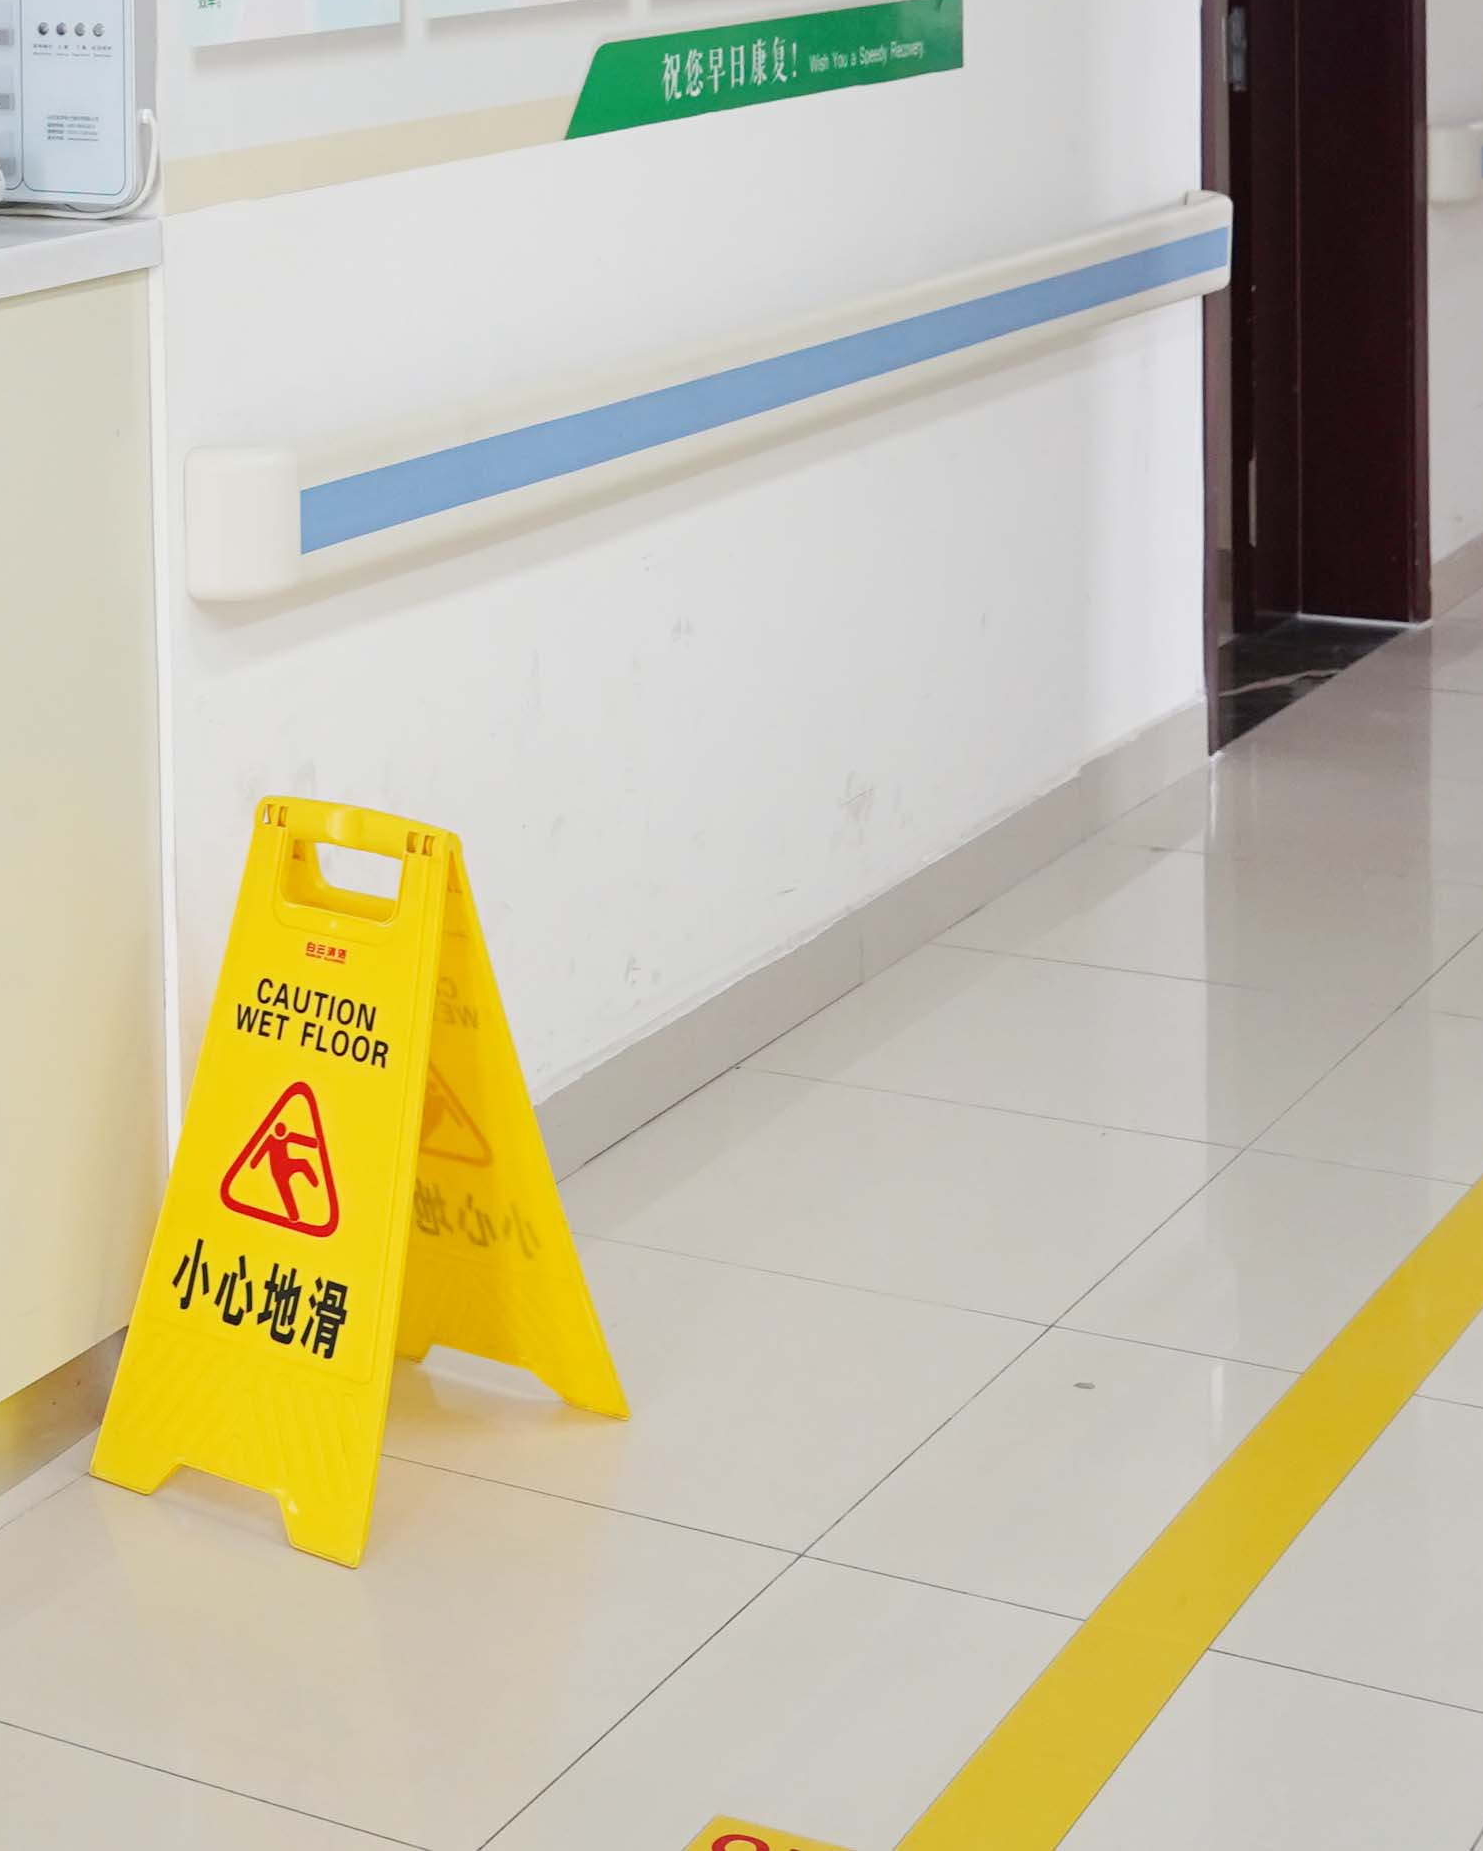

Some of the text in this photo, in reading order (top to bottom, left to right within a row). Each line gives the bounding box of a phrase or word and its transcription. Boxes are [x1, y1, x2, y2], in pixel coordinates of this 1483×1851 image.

[236, 1003, 390, 1070] WET FLOOR
[255, 977, 378, 1033] CAUTION
[172, 1238, 349, 1360] 小心地滑
